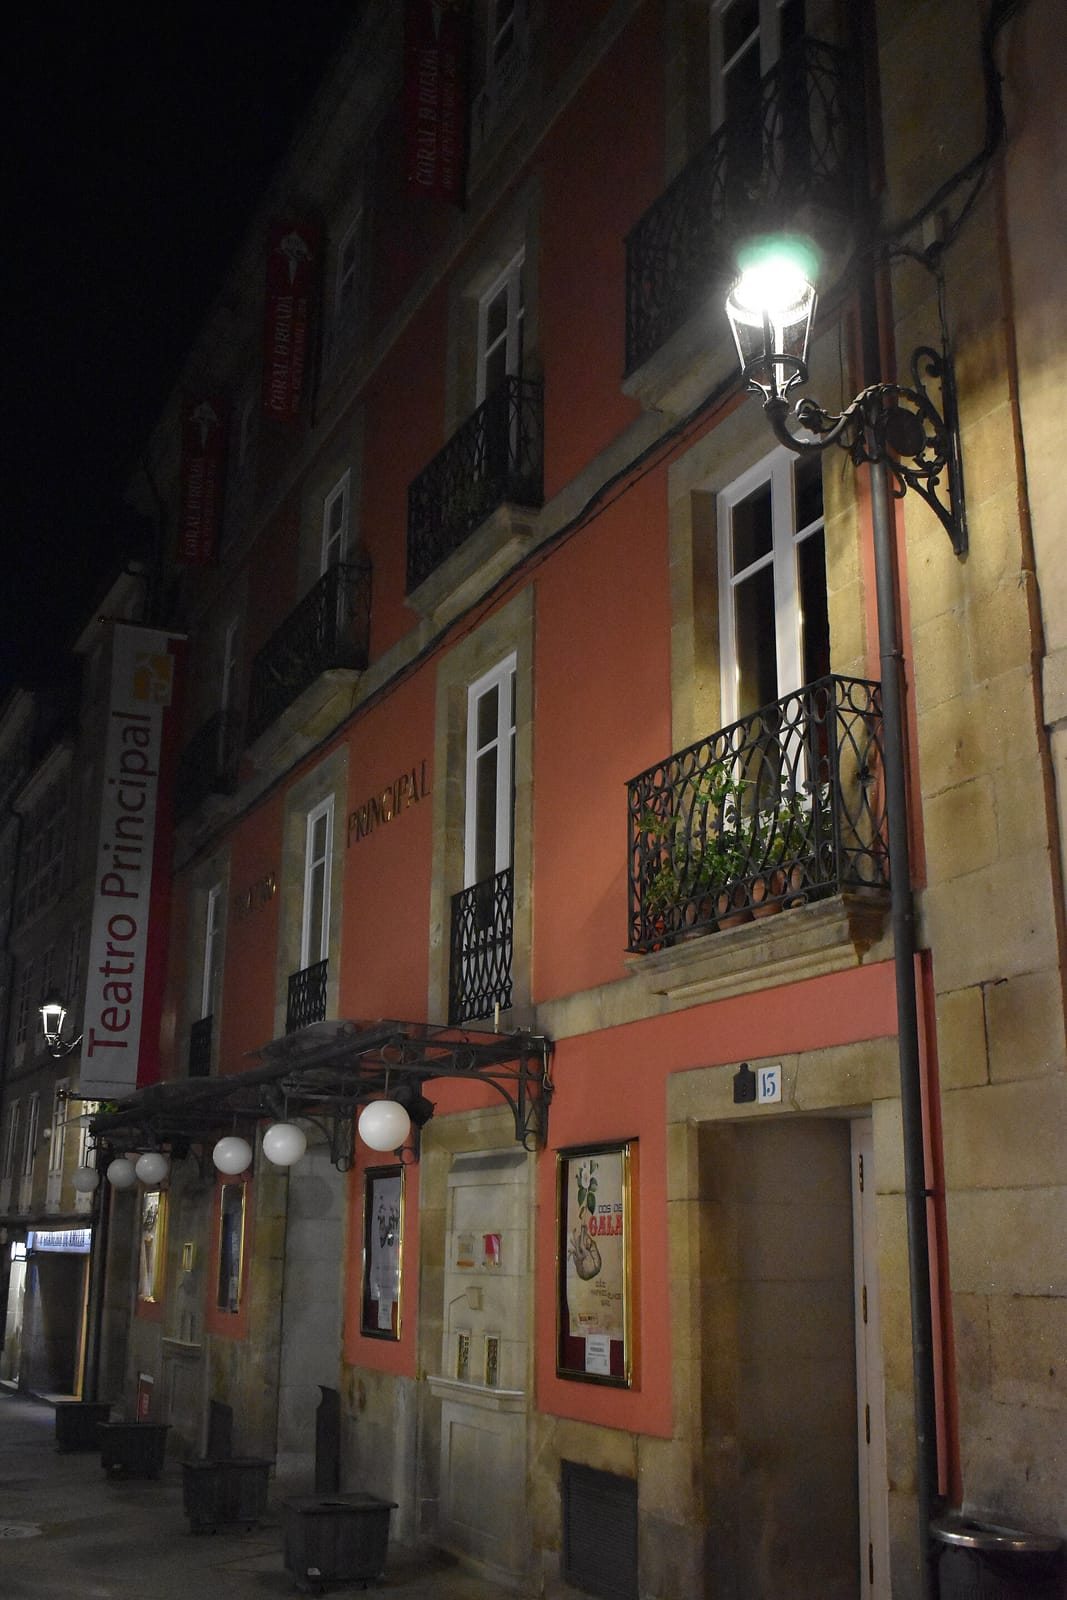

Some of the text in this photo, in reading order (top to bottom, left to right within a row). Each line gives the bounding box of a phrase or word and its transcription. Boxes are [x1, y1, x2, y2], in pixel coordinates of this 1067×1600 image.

[415, 127, 437, 186] CORAL
[271, 362, 289, 411] CORAL
[346, 758, 431, 848] PRINCIPAL
[87, 710, 158, 1057] Teatro Principal
[762, 1072, 776, 1097] 15
[588, 1214, 624, 1237] GALA
